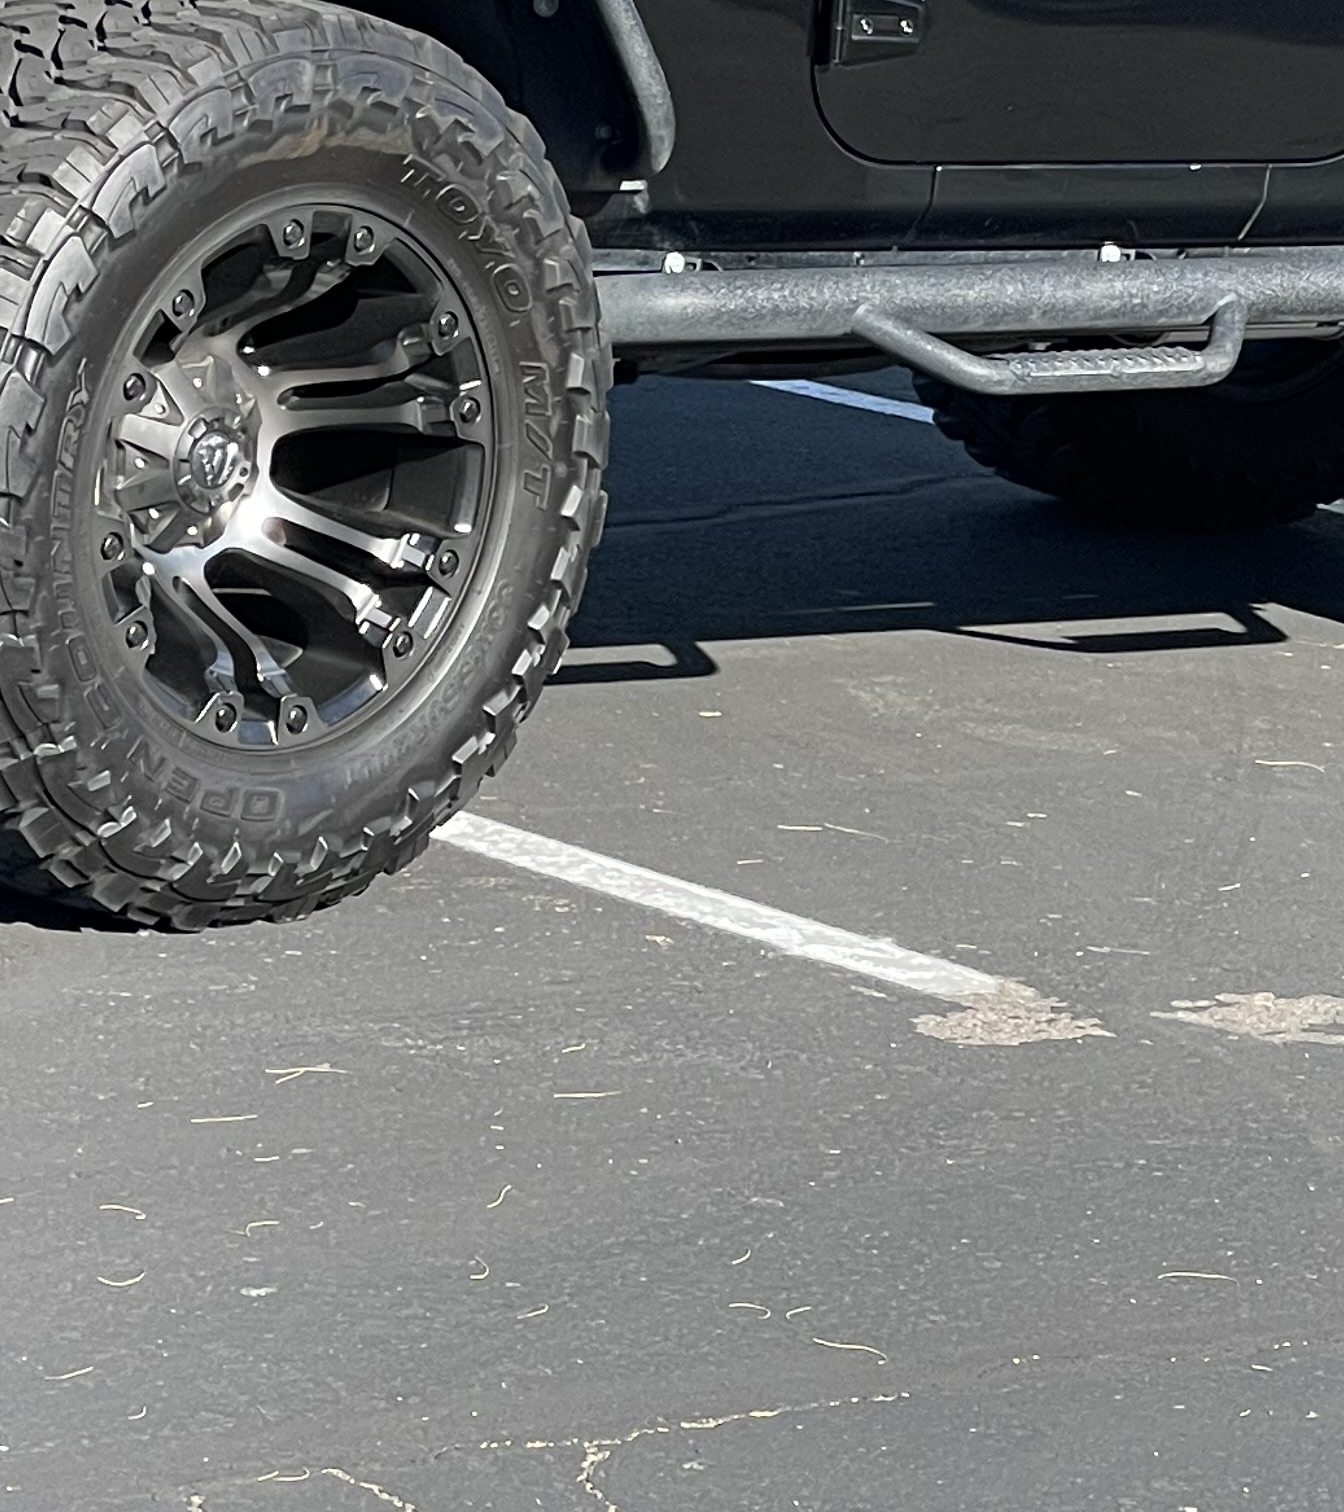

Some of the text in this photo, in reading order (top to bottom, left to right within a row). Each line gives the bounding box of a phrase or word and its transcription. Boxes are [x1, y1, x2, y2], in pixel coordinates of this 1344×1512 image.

[400, 152, 534, 313] TOYO
[518, 361, 554, 511] M/T
[52, 357, 285, 822] OPEN COUNTRY
